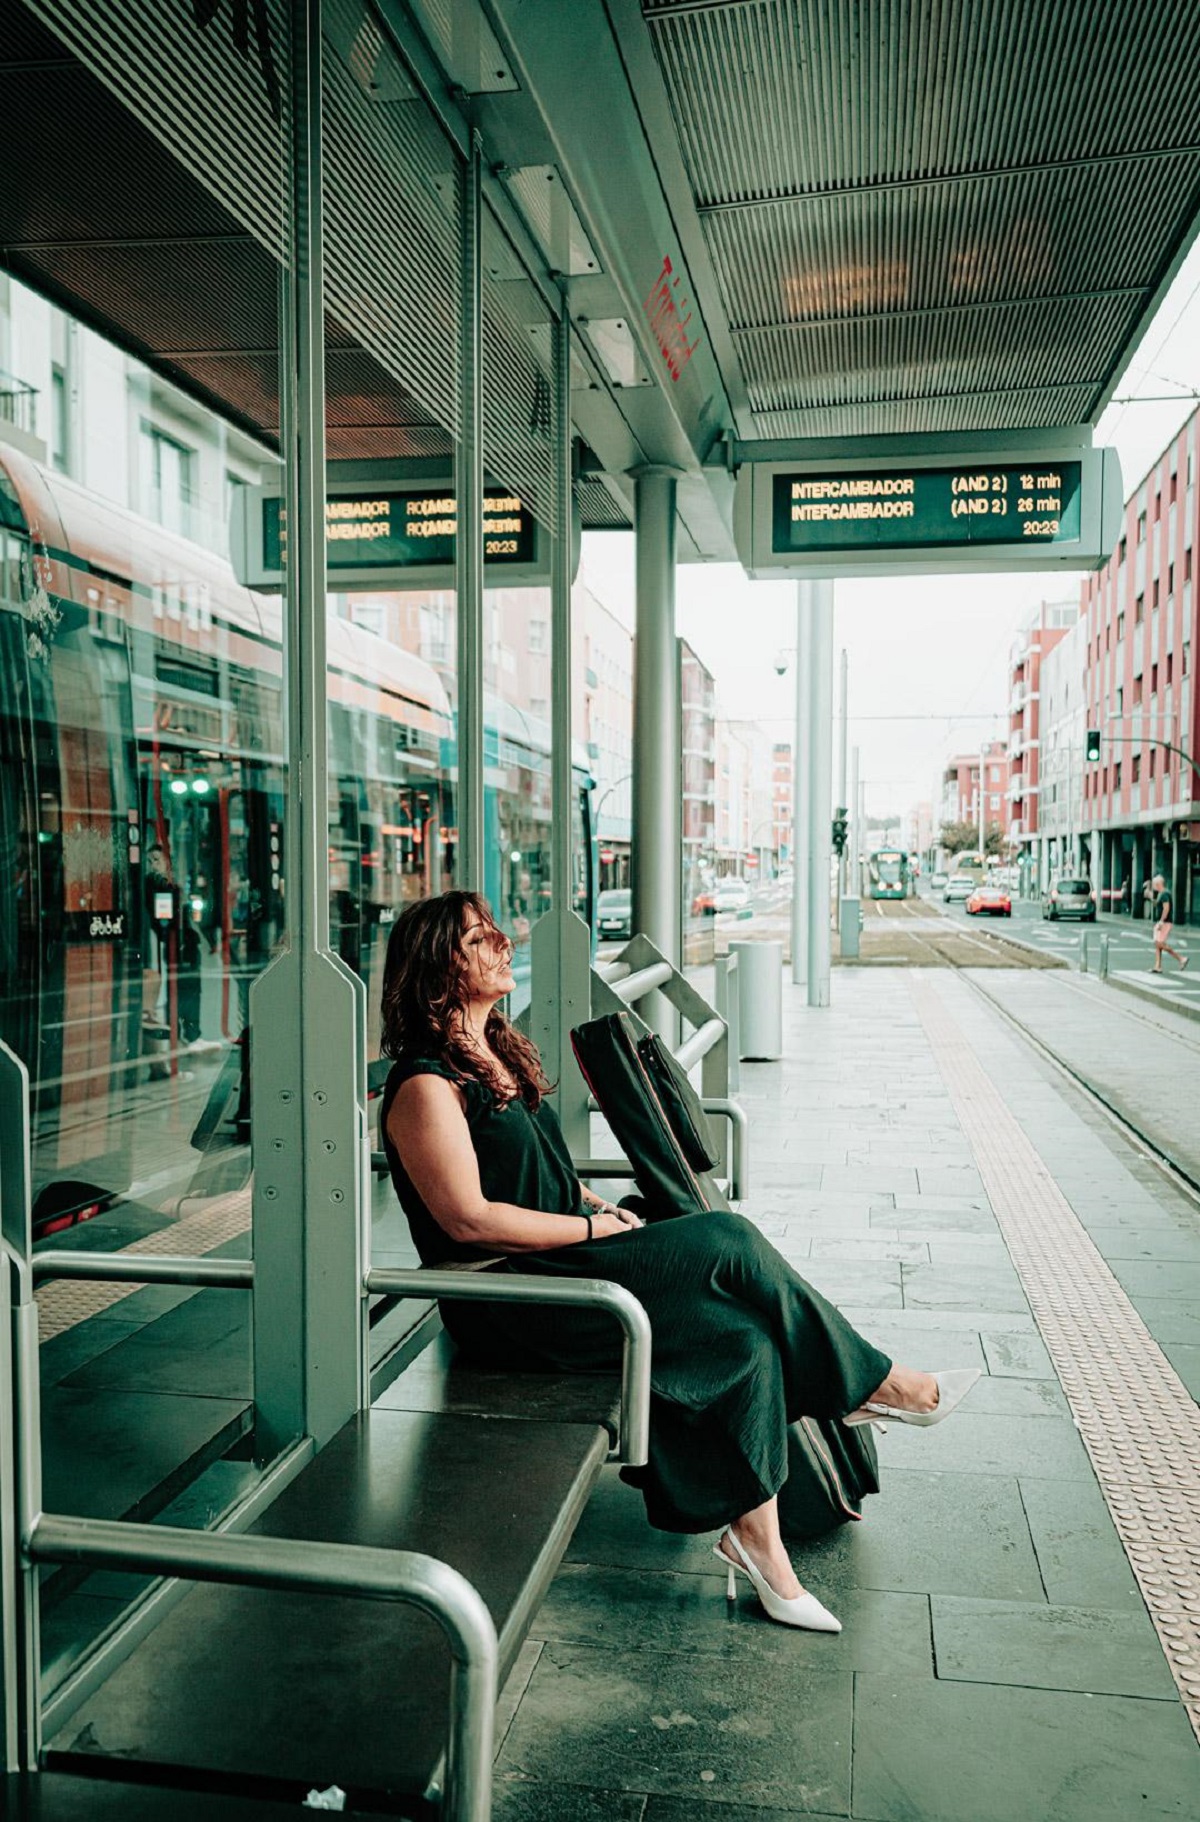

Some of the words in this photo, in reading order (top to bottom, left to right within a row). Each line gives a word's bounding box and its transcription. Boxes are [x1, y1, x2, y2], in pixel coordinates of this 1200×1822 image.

[791, 479, 914, 499] INTERCAMBIADOR
[951, 475, 989, 495] (AND
[991, 474, 1007, 494] 2)
[1020, 474, 1034, 490] 12
[1037, 472, 1061, 489] min
[791, 501, 914, 521] INTERCAMBIADOR
[951, 498, 989, 518] (AND
[991, 497, 1007, 516] 2)
[1036, 494, 1061, 512] min
[1023, 520, 1059, 535] 20:23
